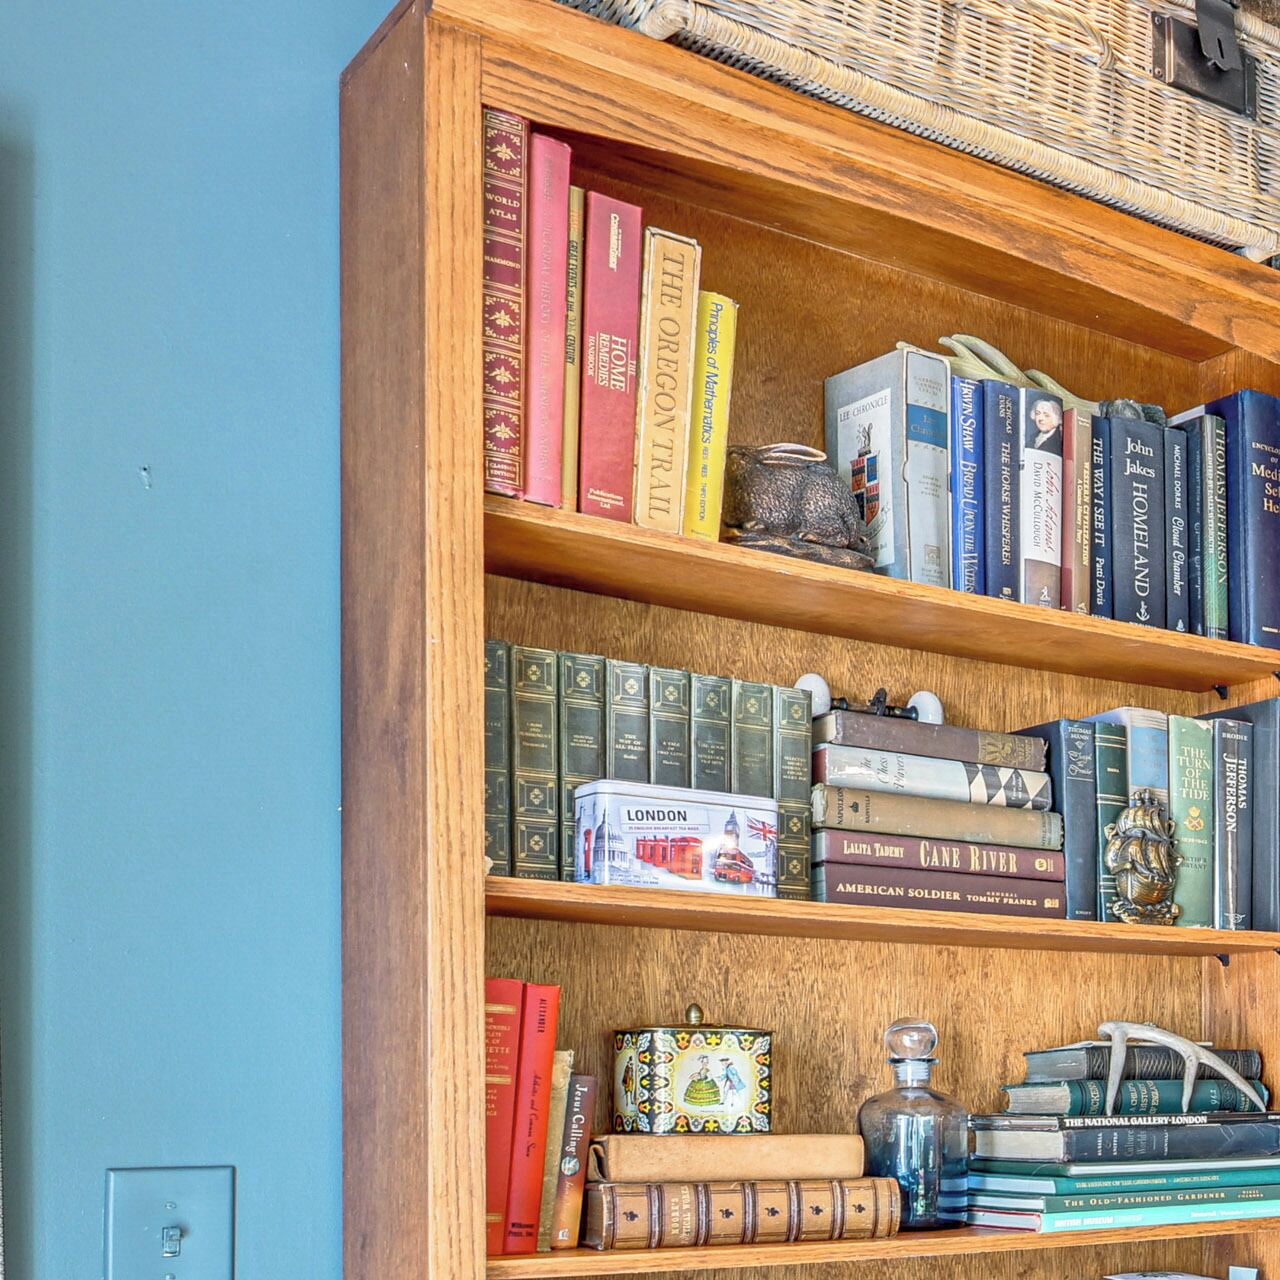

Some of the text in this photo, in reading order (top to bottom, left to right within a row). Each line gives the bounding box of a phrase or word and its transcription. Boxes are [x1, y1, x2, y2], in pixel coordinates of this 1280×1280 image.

[485, 192, 520, 208] WORLD
[489, 207, 517, 221] ATLAS
[484, 254, 521, 269] HAMMOND
[587, 335, 598, 377] HANDBOOK
[598, 332, 611, 387] REMEDIES
[610, 335, 627, 392] HOME
[648, 251, 685, 520] THE OREGON TRAIL
[840, 394, 889, 424] LEE CHRONICLE
[1124, 437, 1154, 457] John
[1124, 458, 1156, 478] Jakes
[960, 380, 979, 595] IRWIN SHAW BREAD UPON THE WATERS
[1000, 442, 1014, 566] THE HORSE WHISPERER
[1082, 461, 1090, 566] WESTERN CIVILIZATION
[1216, 427, 1227, 583] THOMAS JEFFERSON
[1093, 438, 1106, 605] THE WAY I SEE IT Patti Davis
[1172, 444, 1185, 596] MICHAEL DORRIS Cloud Chamber
[1132, 481, 1150, 597] HOMELAND
[1176, 756, 1211, 770] TURN
[1181, 746, 1207, 758] THE
[1181, 778, 1208, 791] THE
[1185, 768, 1202, 779] OF
[1237, 758, 1247, 809] THOMAS
[1179, 788, 1209, 801] TIDE
[1223, 753, 1237, 833] JEFFERSON
[626, 809, 687, 822] LONDON
[843, 840, 1018, 873] LALITA TADEMY CANE RIVER
[836, 883, 961, 901] AMERICAN SOLDIER
[966, 894, 1037, 906] TOMMY FRANKS
[565, 1084, 588, 1155] Jesus Calling
[1064, 1115, 1207, 1126] THE NATIONAL GALLERY LONDON
